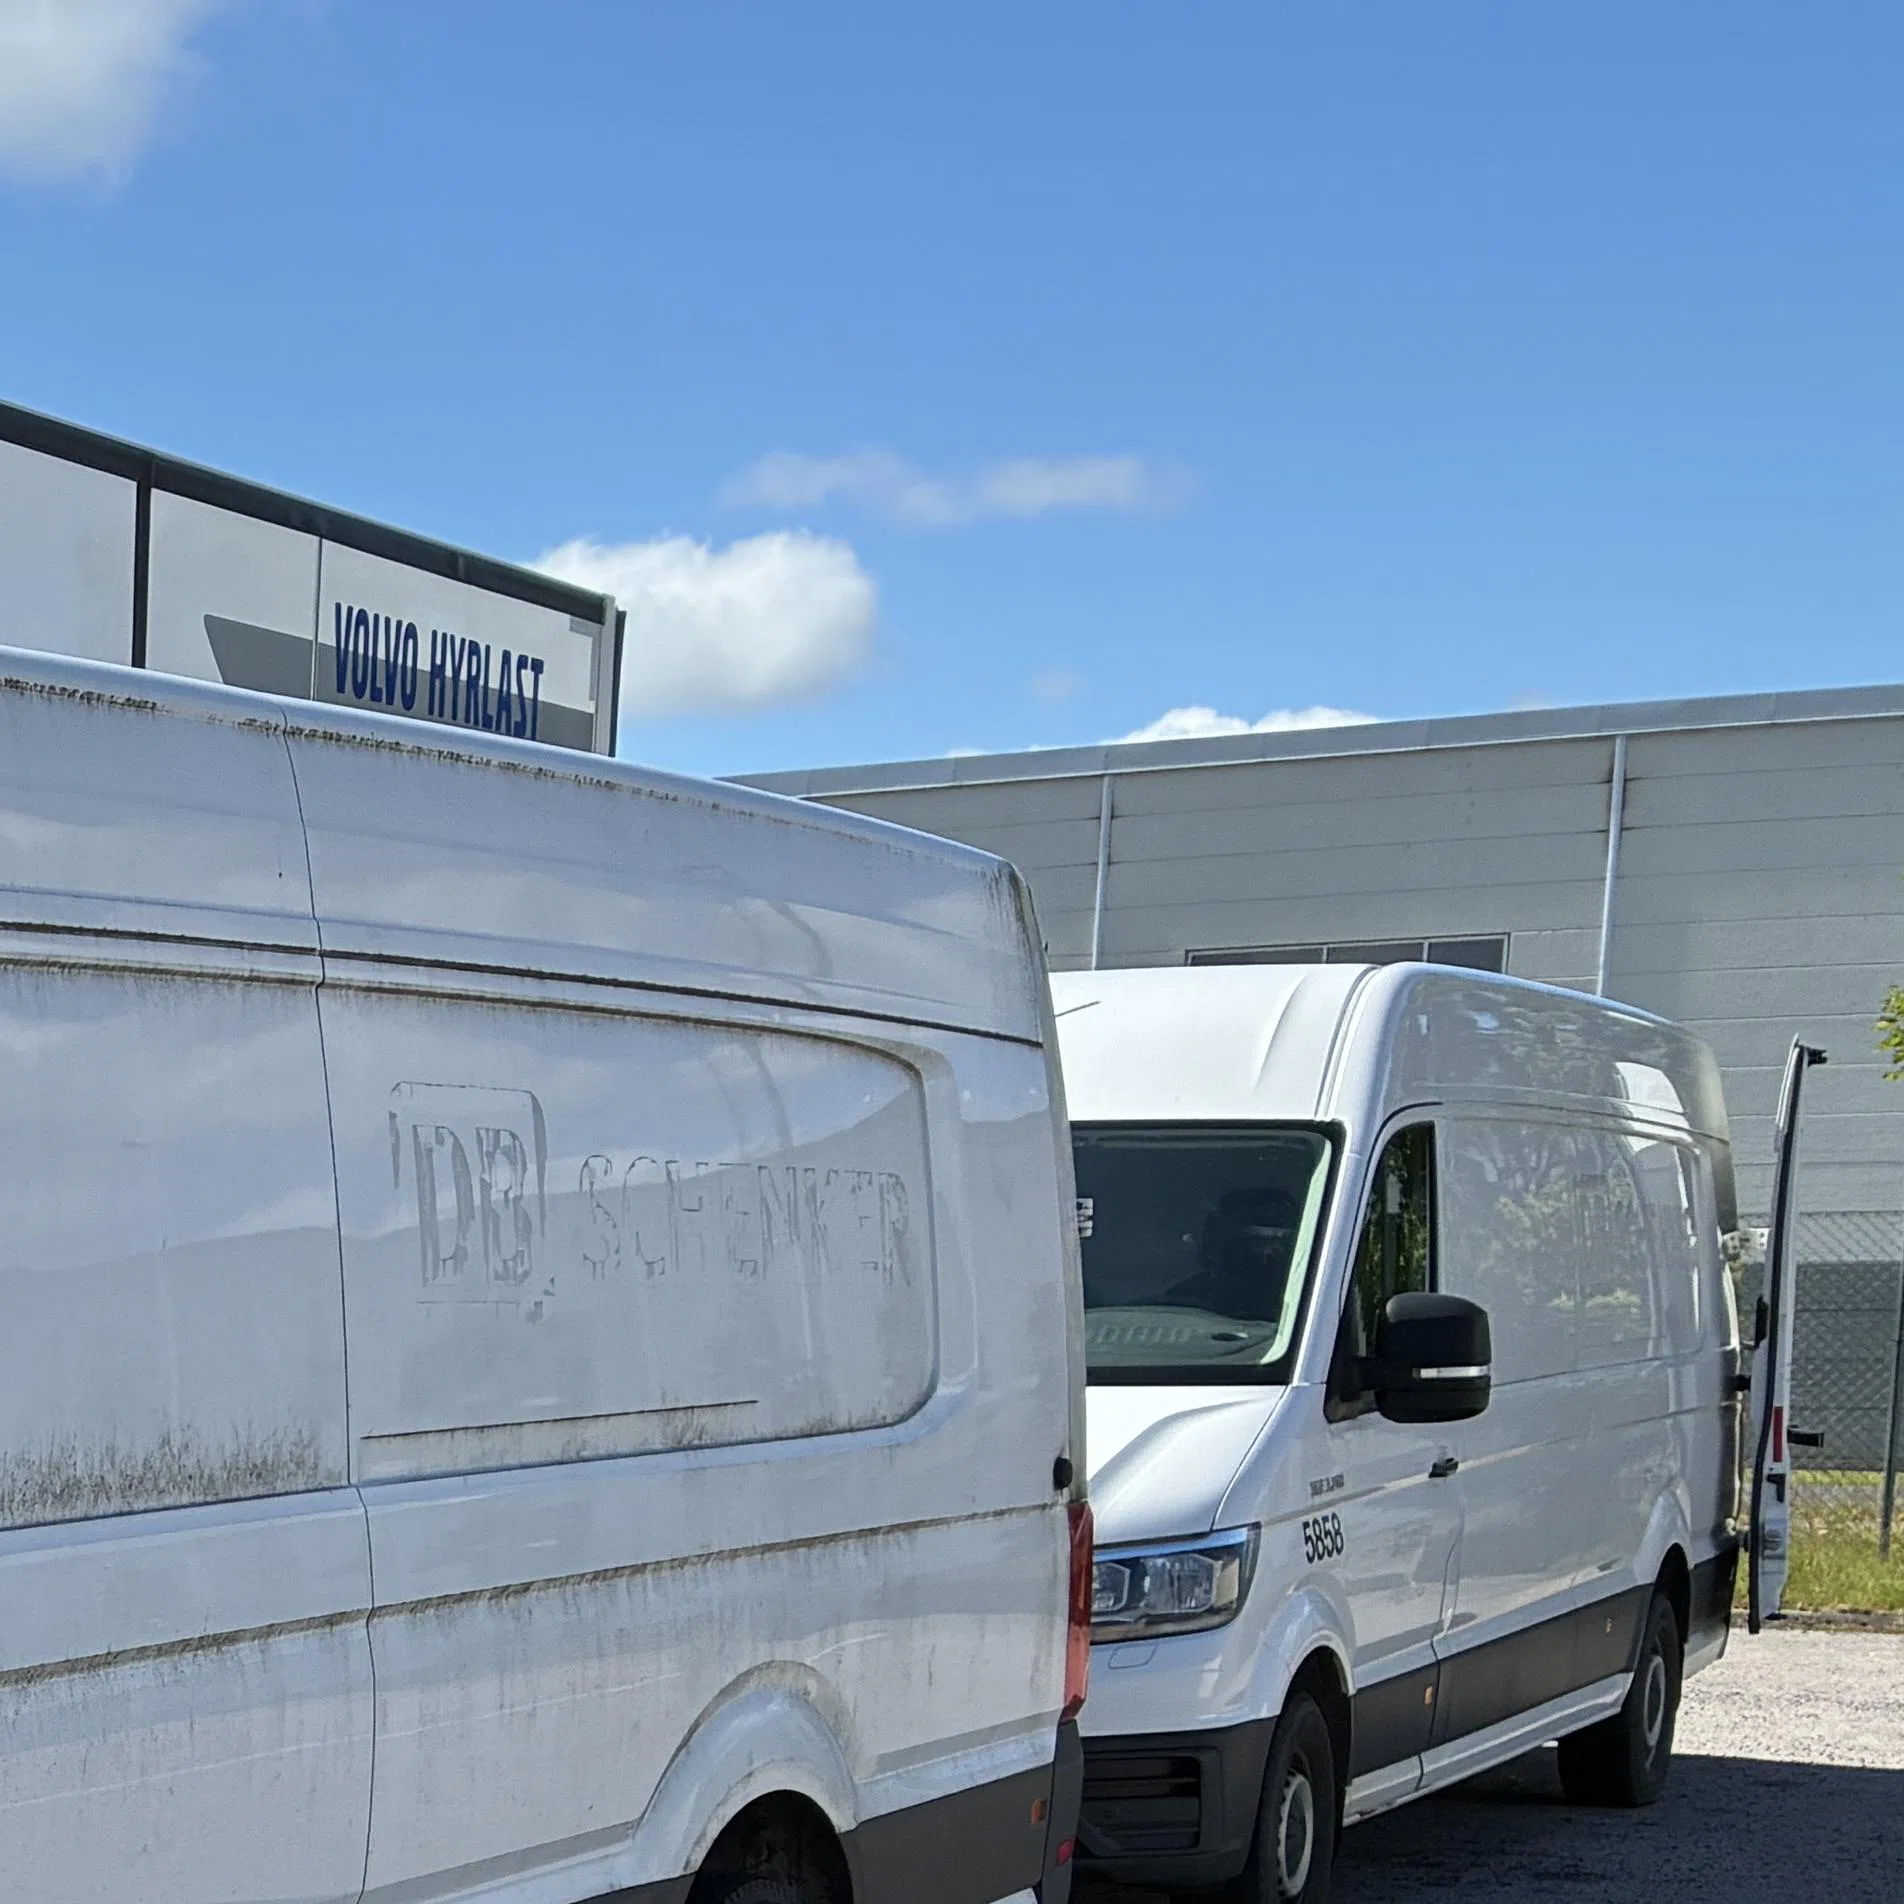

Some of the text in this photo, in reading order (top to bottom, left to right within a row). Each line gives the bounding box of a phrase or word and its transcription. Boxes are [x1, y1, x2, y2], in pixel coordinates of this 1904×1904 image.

[335, 602, 544, 741] VOLVO HYRLAST
[412, 1124, 533, 1288] DB
[1302, 1512, 1344, 1564] 5858
